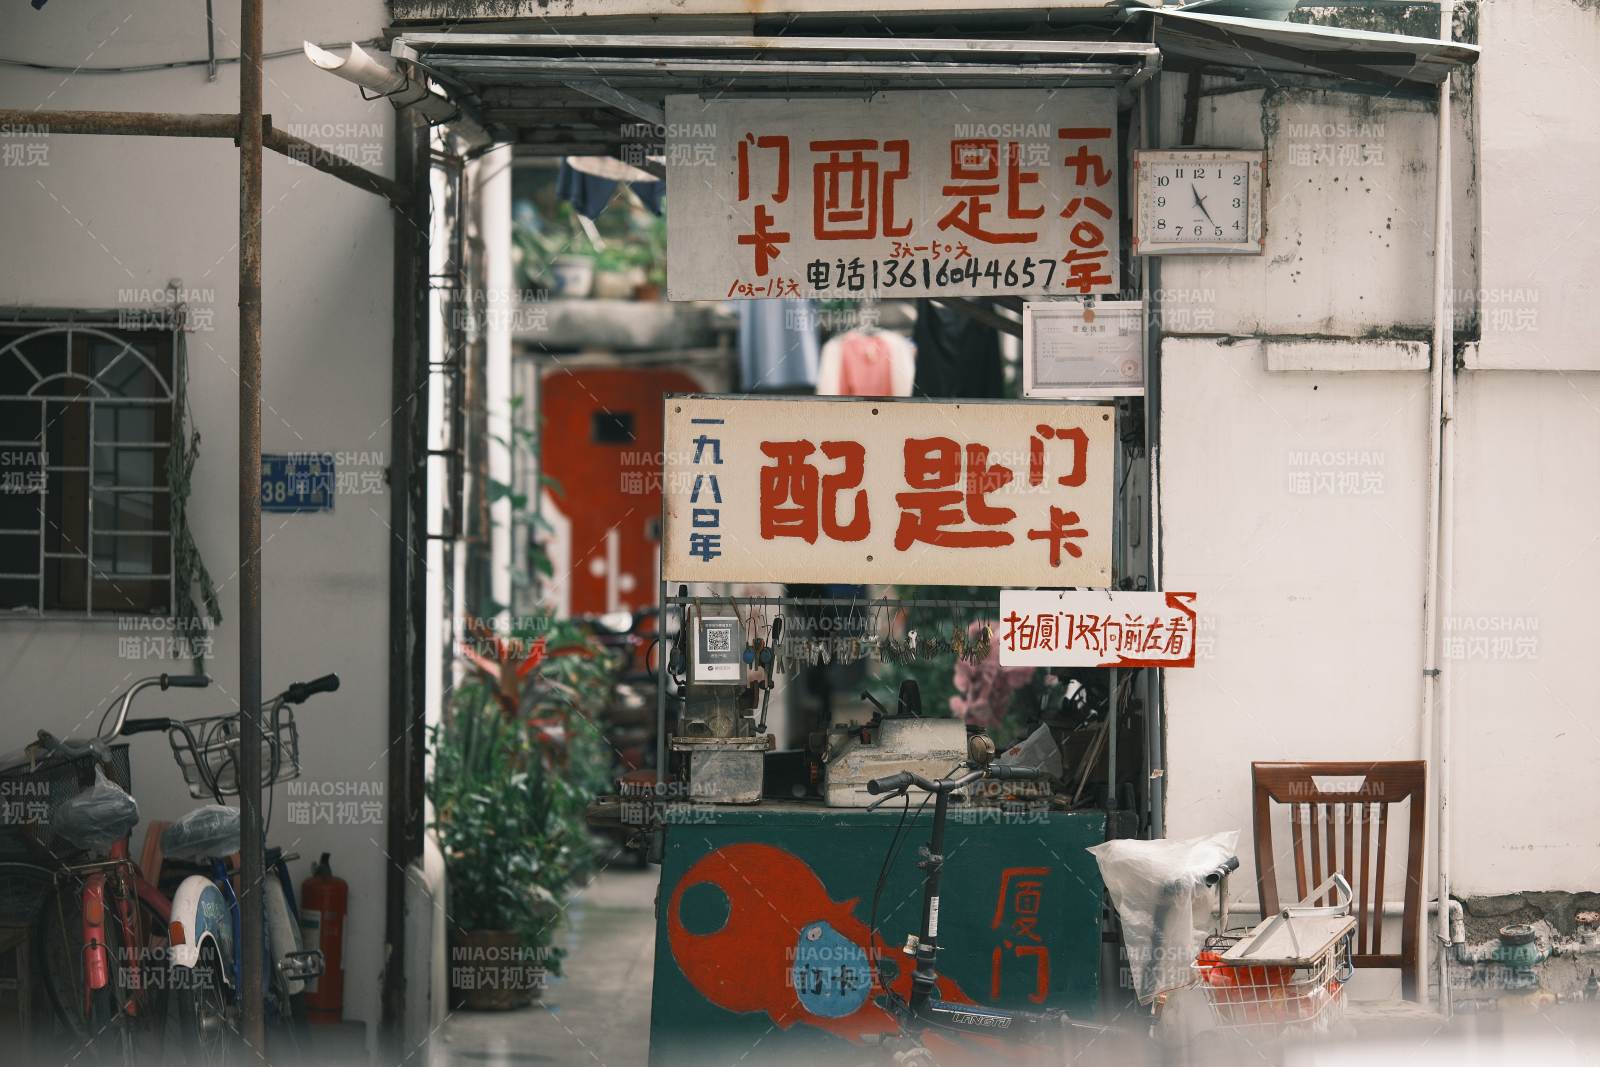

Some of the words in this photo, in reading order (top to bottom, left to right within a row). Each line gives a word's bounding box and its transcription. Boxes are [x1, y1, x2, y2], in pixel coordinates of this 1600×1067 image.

[1175, 169, 1184, 179] 11
[1193, 168, 1205, 179] 12
[1217, 169, 1222, 179] 1
[1157, 176, 1170, 187] 10
[1232, 175, 1241, 186] 2
[809, 139, 1045, 244] 配匙
[738, 132, 790, 276] 门卡
[1157, 196, 1166, 207] 9
[1232, 198, 1241, 208] 3
[1157, 218, 1166, 230] 8
[1232, 220, 1241, 230] 4
[1175, 225, 1184, 236] 7
[1194, 225, 1202, 236] 6
[1214, 226, 1223, 236] 5
[759, 436, 1017, 551] 配匙
[1027, 423, 1089, 568] 门卡
[991, 866, 1053, 1004] 厦门
